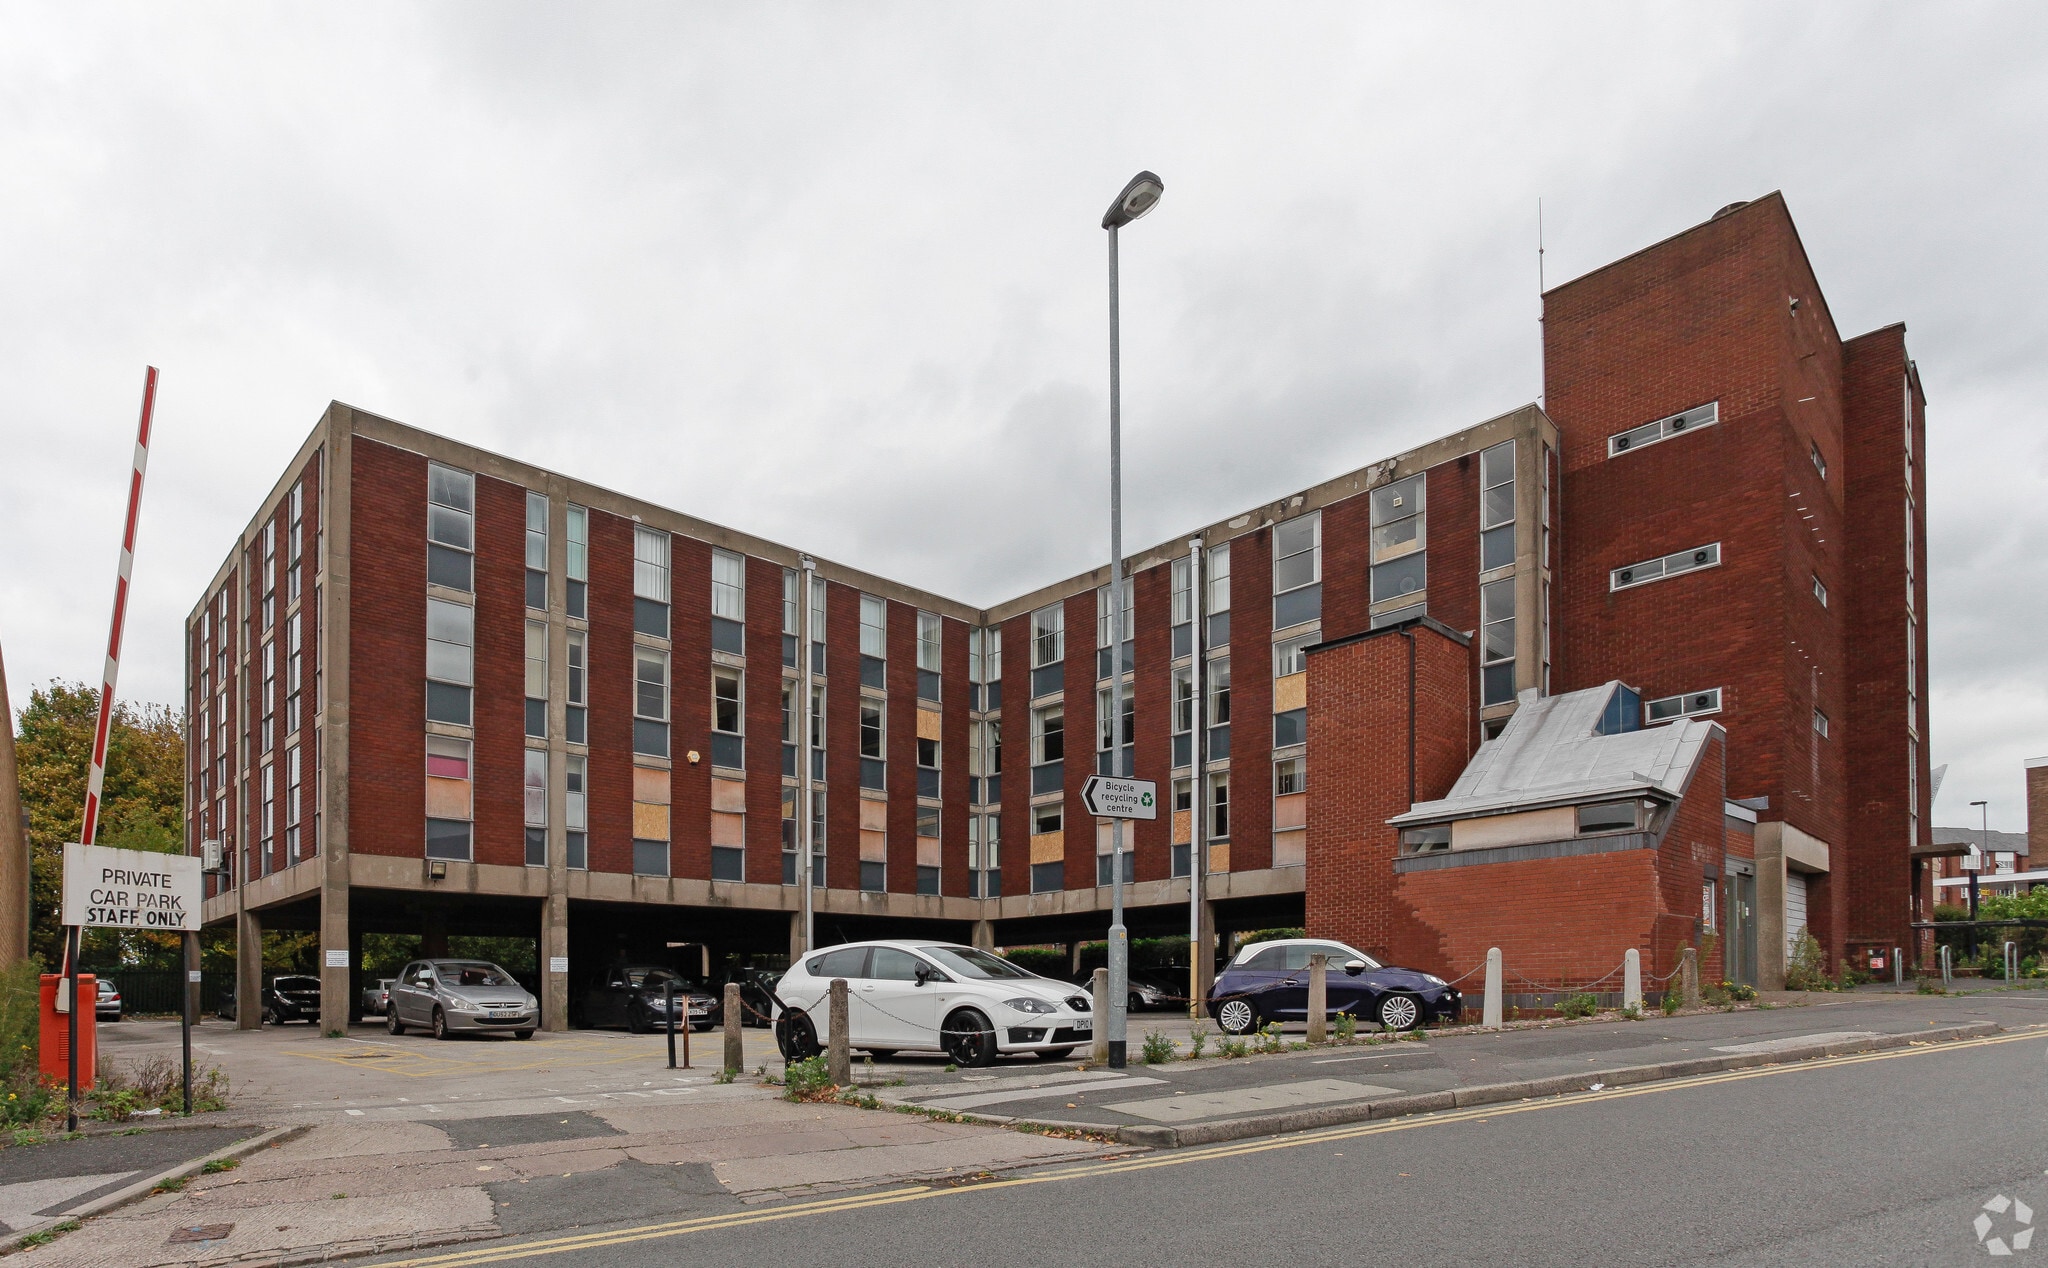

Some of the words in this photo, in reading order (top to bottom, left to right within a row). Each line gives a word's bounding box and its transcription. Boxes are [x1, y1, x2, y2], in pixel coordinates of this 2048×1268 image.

[1105, 781, 1135, 793] Bicycle
[1101, 793, 1138, 804] recycling
[1106, 804, 1133, 813] centre
[102, 868, 172, 889] PRIVATE
[90, 889, 129, 906] CAR
[137, 892, 182, 910] PARK
[87, 907, 139, 924] STAFF
[146, 910, 186, 926] ONLY
